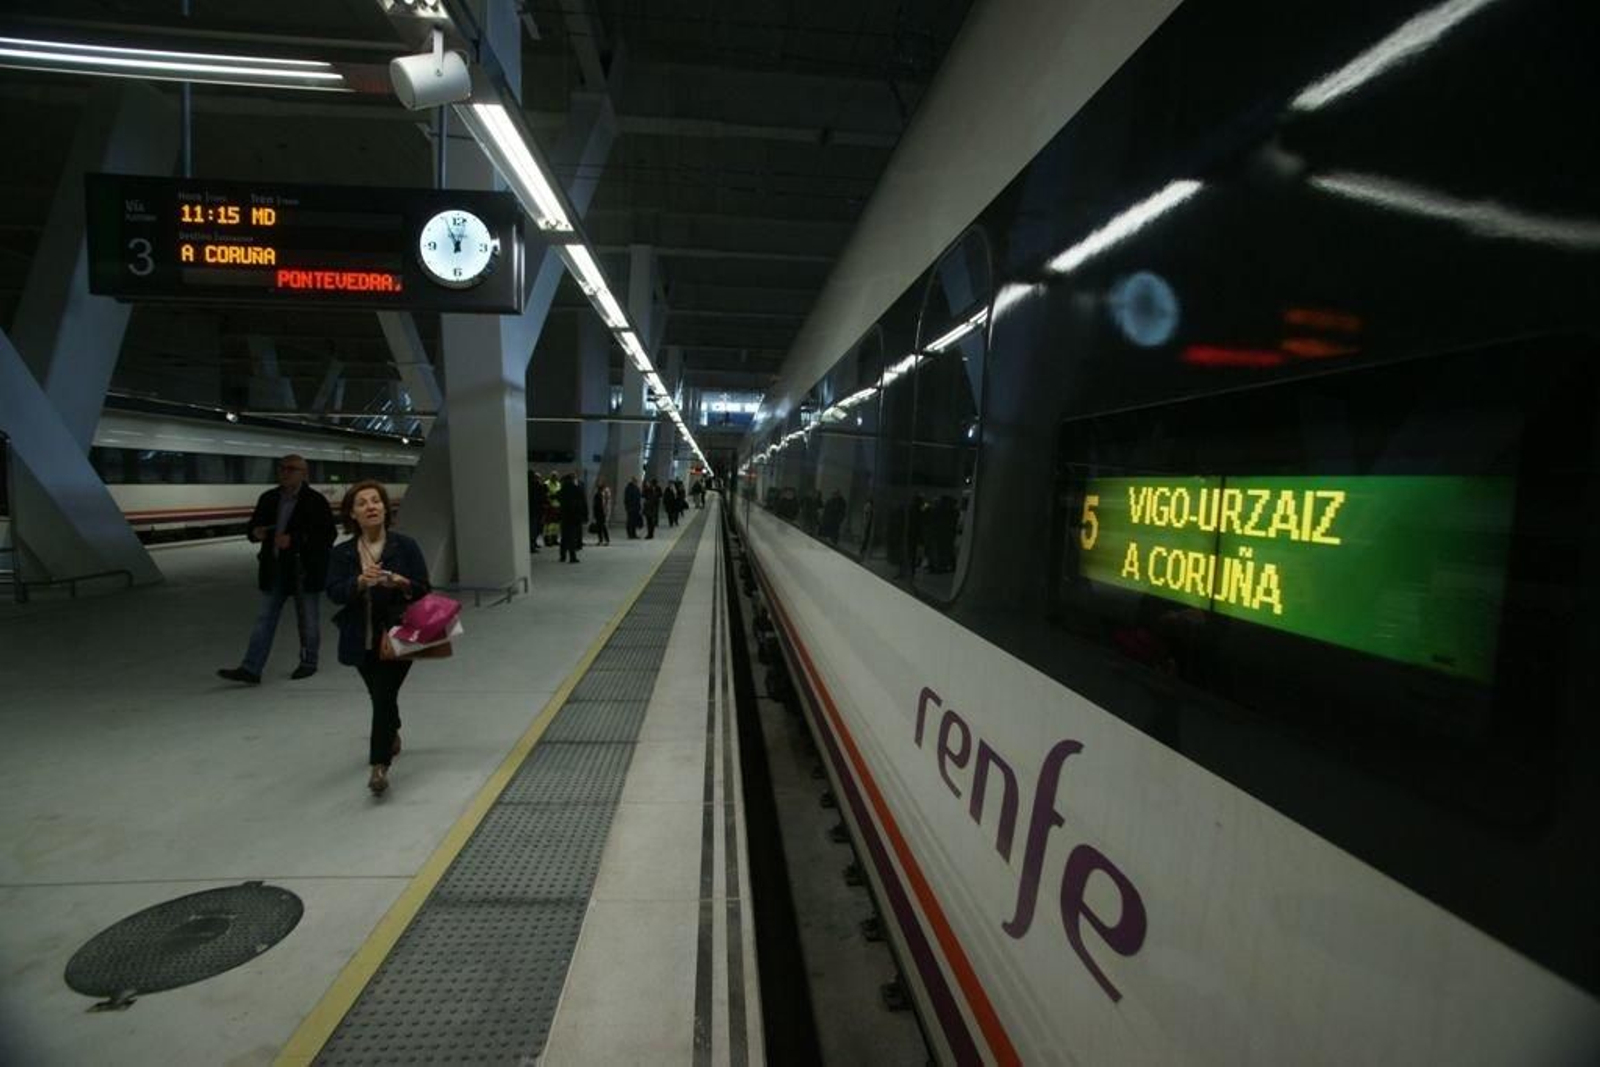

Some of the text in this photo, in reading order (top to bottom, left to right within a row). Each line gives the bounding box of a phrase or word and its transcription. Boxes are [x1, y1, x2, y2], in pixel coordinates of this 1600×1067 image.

[181, 204, 276, 226] 11:15 MD
[127, 238, 155, 276] 3
[181, 244, 276, 266] A CORUÑA
[1080, 495, 1099, 550] 5
[1128, 486, 1345, 545] VIGO-URZAIZ
[1122, 542, 1283, 614] A CORUÑA
[914, 686, 1148, 1003] renfe
